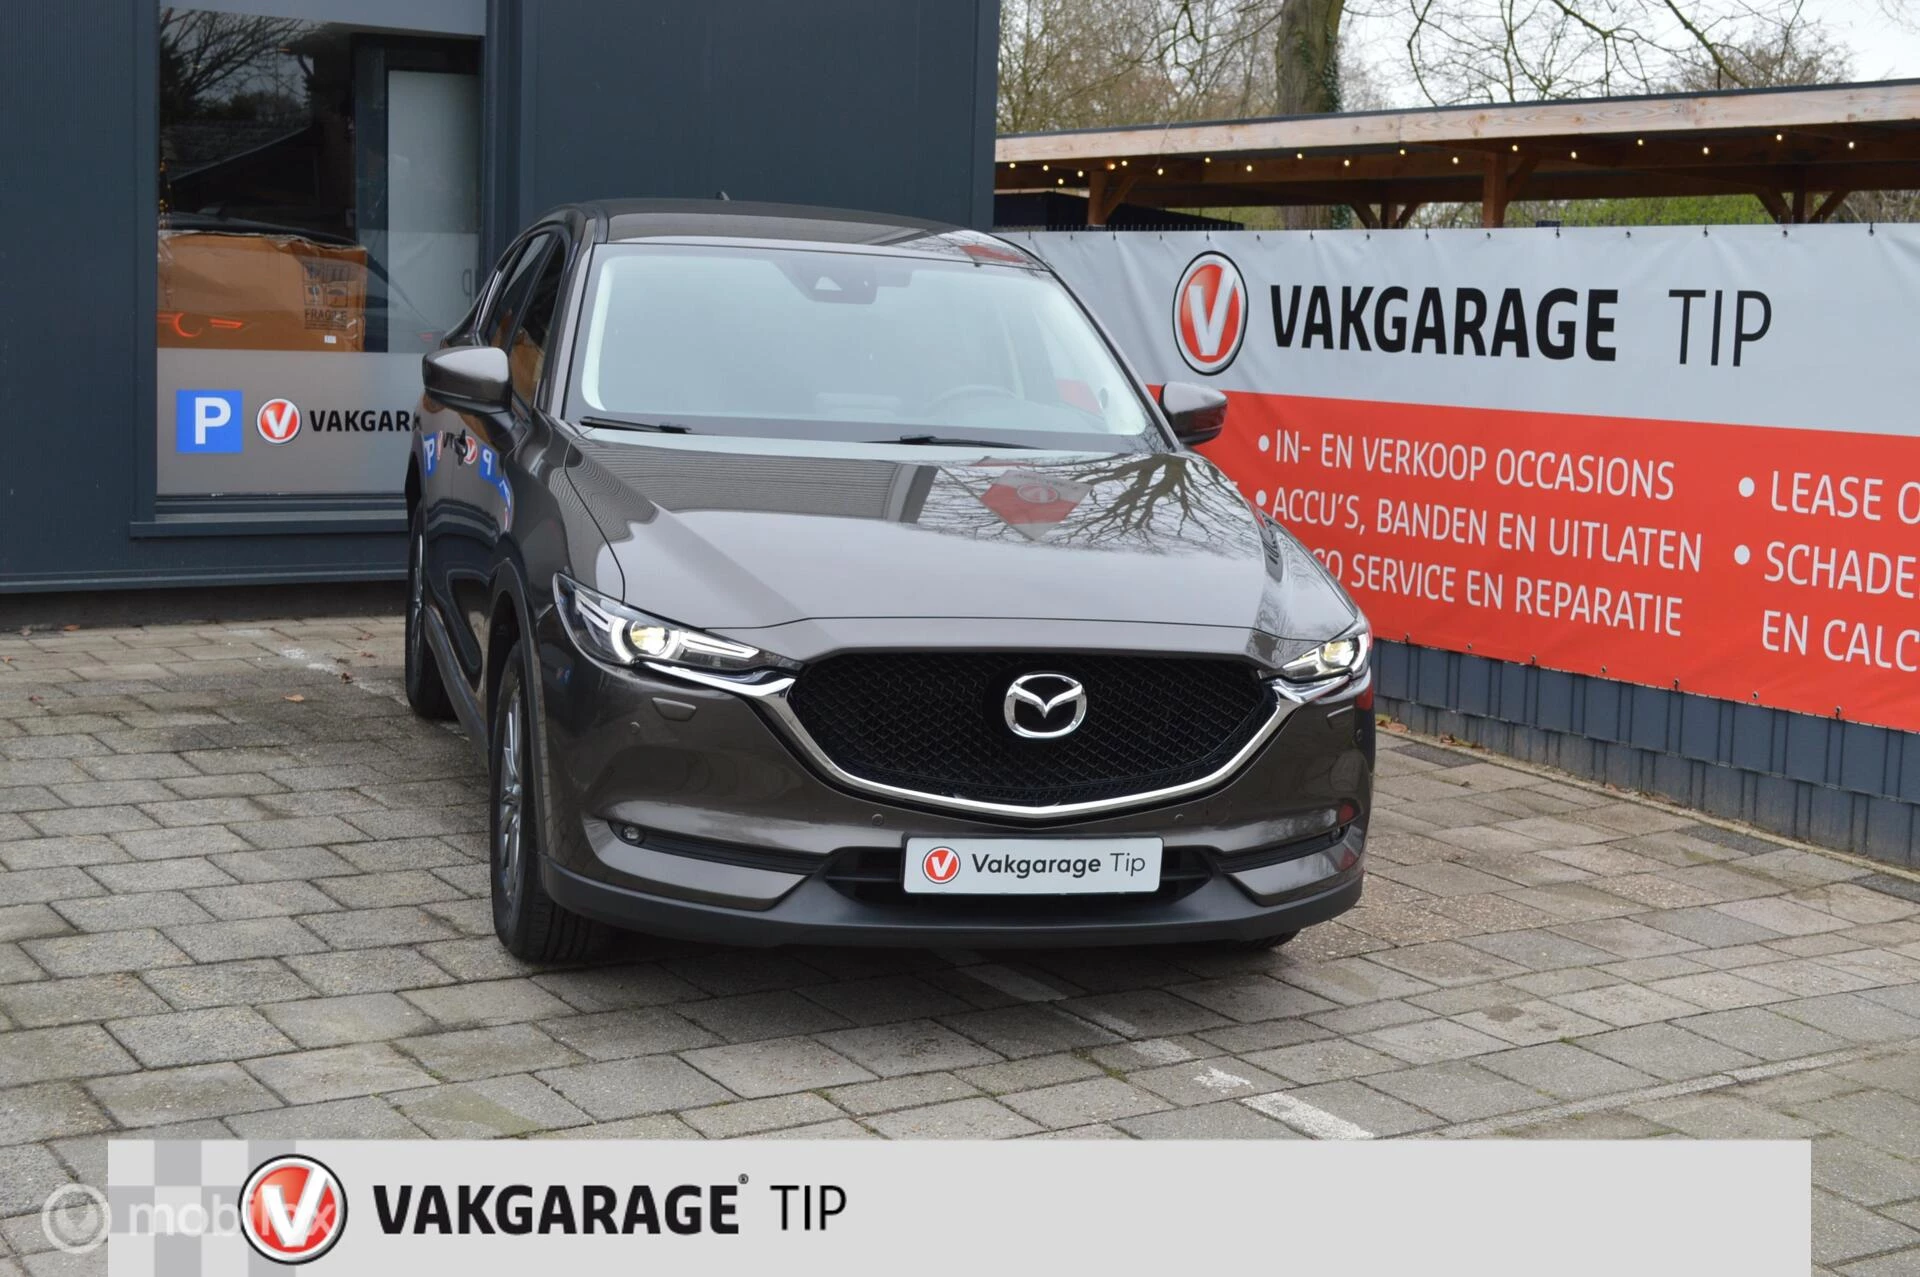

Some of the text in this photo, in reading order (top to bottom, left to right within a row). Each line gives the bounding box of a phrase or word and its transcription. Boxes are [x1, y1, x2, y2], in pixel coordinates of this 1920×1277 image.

[1269, 284, 1619, 363] VAKGARAGE
[1668, 289, 1772, 367] TIP
[195, 397, 231, 445] P
[1275, 429, 1675, 501] IN- EN VERKOOP OCCASIONS
[1771, 470, 1920, 525] LEASE O
[1272, 487, 1702, 573] ACCU'S, BANDEN EN UITLATEN
[1351, 553, 1456, 603] SERVICE
[1466, 569, 1503, 610] EN
[1515, 576, 1683, 637] REPARATIE
[1764, 541, 1920, 599] SCHADE
[1762, 609, 1920, 672] EN CALC
[971, 853, 1102, 880] Vakgarage
[1109, 852, 1146, 877] Tip
